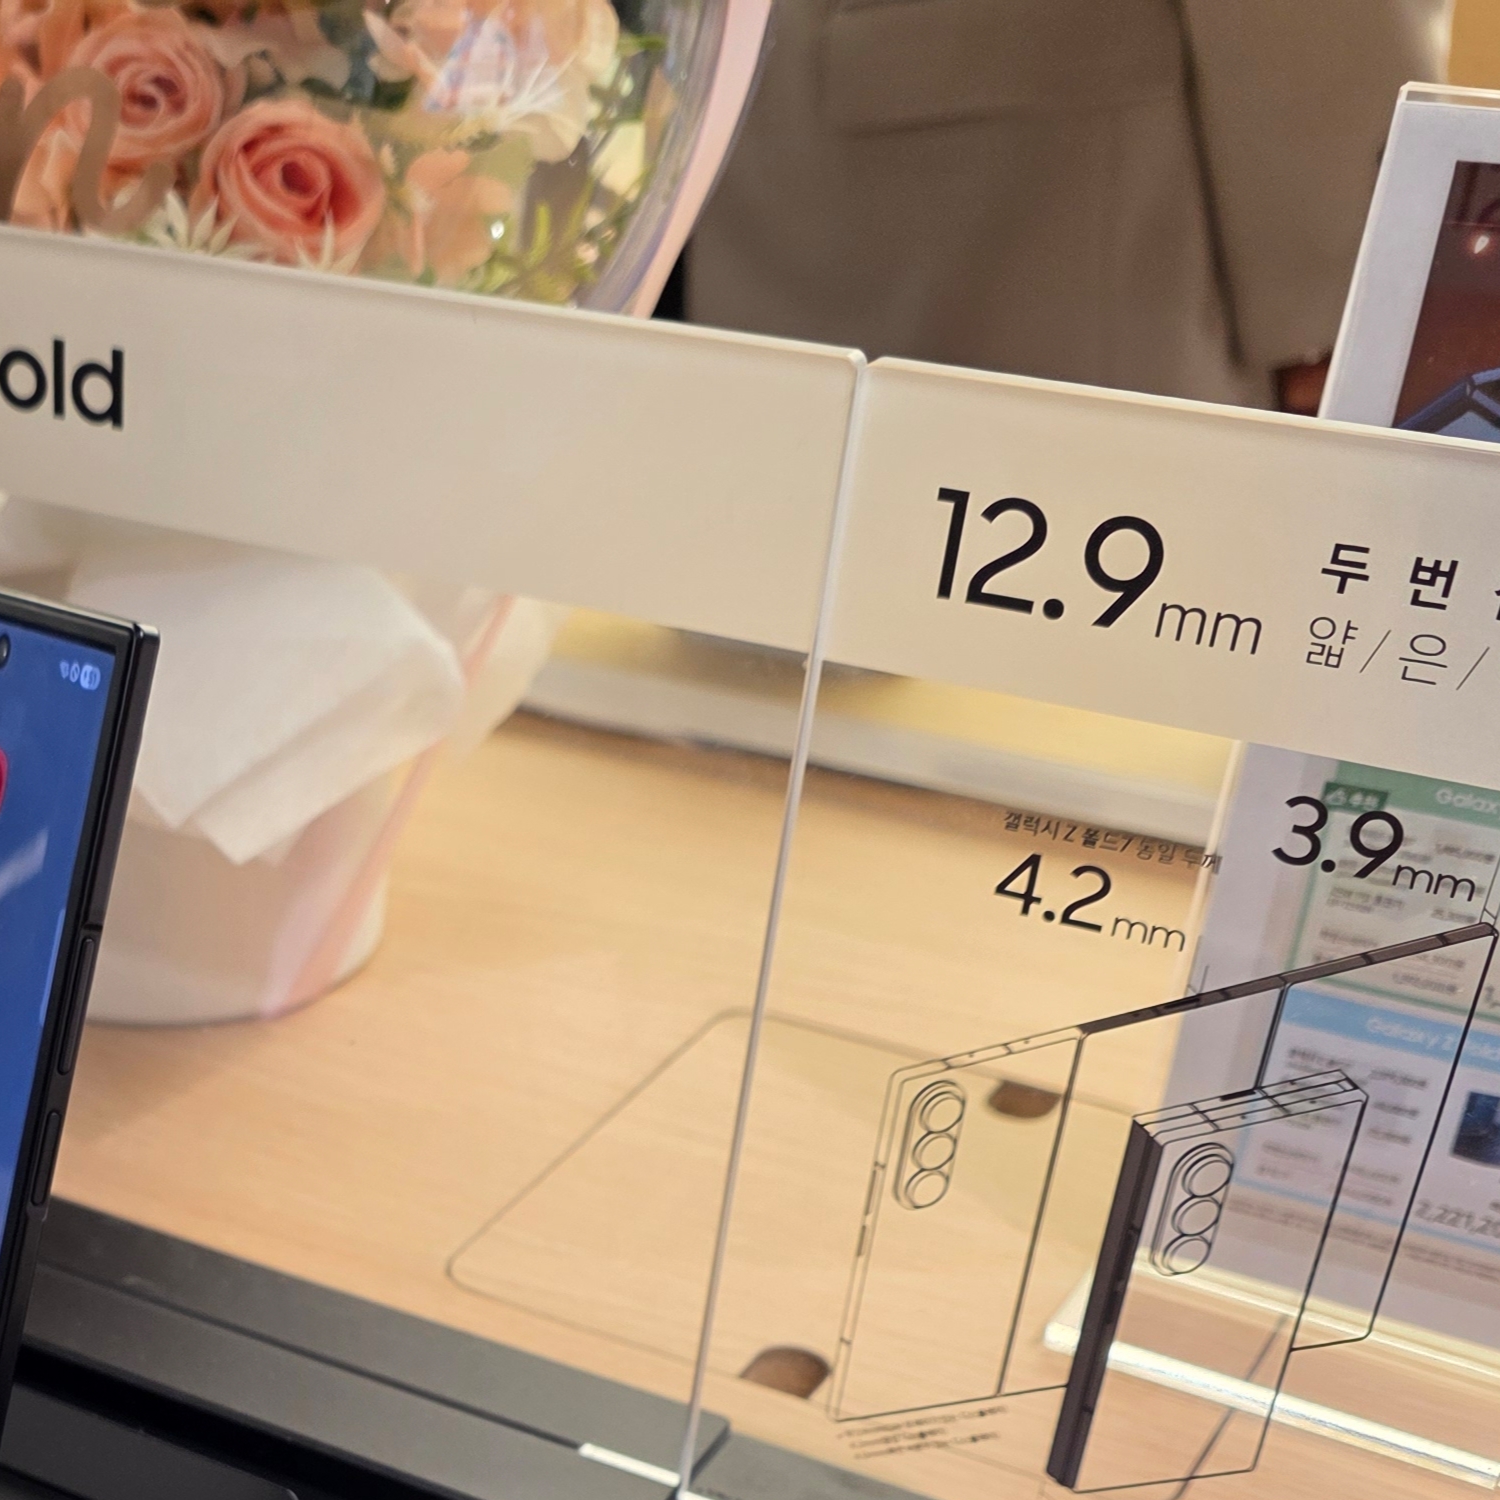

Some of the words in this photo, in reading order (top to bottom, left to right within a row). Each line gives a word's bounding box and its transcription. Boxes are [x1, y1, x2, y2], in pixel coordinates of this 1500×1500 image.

[1320, 542, 1371, 595] 두
[1409, 556, 1460, 611] 번
[1003, 810, 1062, 842] 갤럭시
[1063, 823, 1076, 843] Z
